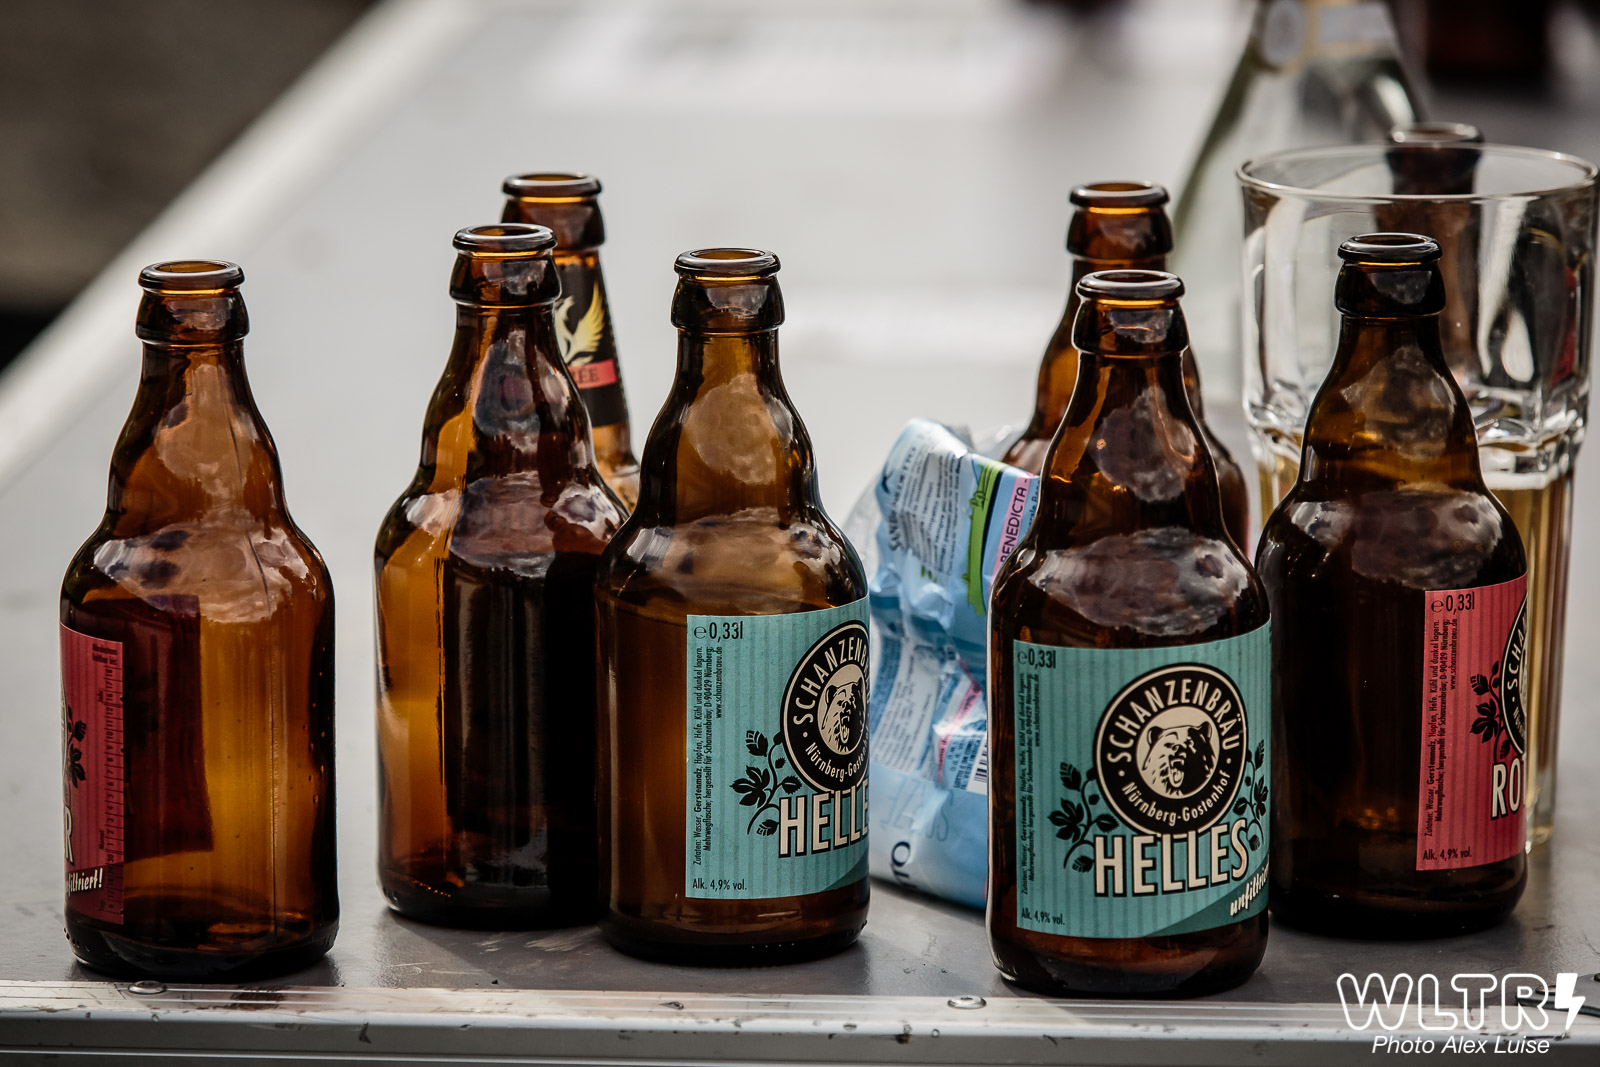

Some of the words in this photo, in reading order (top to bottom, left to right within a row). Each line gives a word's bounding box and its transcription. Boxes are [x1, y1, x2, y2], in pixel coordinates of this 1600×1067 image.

[1431, 619, 1443, 642] lagern.
[693, 646, 705, 668] lagern.
[703, 646, 715, 678] Nürnberg;
[1430, 643, 1439, 664] dunkel
[693, 670, 702, 691] dunkel
[1429, 679, 1438, 693] Kühl
[694, 692, 702, 705] und
[703, 679, 712, 708] D-90429
[1429, 694, 1438, 712] Hefe.
[694, 706, 702, 720] Kühl
[1107, 678, 1242, 764] SCHANZENBRÄU
[1428, 713, 1439, 737] Hopfen,
[694, 722, 703, 739] Hefe.
[703, 709, 714, 754] Schanzenbräu;
[693, 740, 704, 765] Hopfen,
[703, 756, 713, 765] für
[1426, 738, 1436, 785] Gerstenmalz,
[693, 766, 703, 813] Gerstenmalz,
[703, 766, 714, 799] hergestellt
[1121, 771, 1231, 827] Nürnberg-Gostenhof
[1425, 786, 1435, 811] Wasser,
[693, 814, 703, 838] Wasser,
[703, 800, 714, 851] Mehrwegflasche;
[1424, 812, 1432, 837] Zutaten:
[693, 840, 702, 866] Zutaten:
[1094, 817, 1250, 897] HELLES
[1423, 849, 1437, 861] Alk.
[1440, 848, 1458, 861] 4,9%
[1460, 846, 1472, 858] vol.
[692, 878, 707, 890] Alk.
[710, 879, 730, 892] 4,9%
[732, 879, 747, 891] vol.
[1021, 907, 1032, 920] Alk.
[1034, 910, 1051, 924] 4,9%
[1052, 914, 1066, 926] vol.
